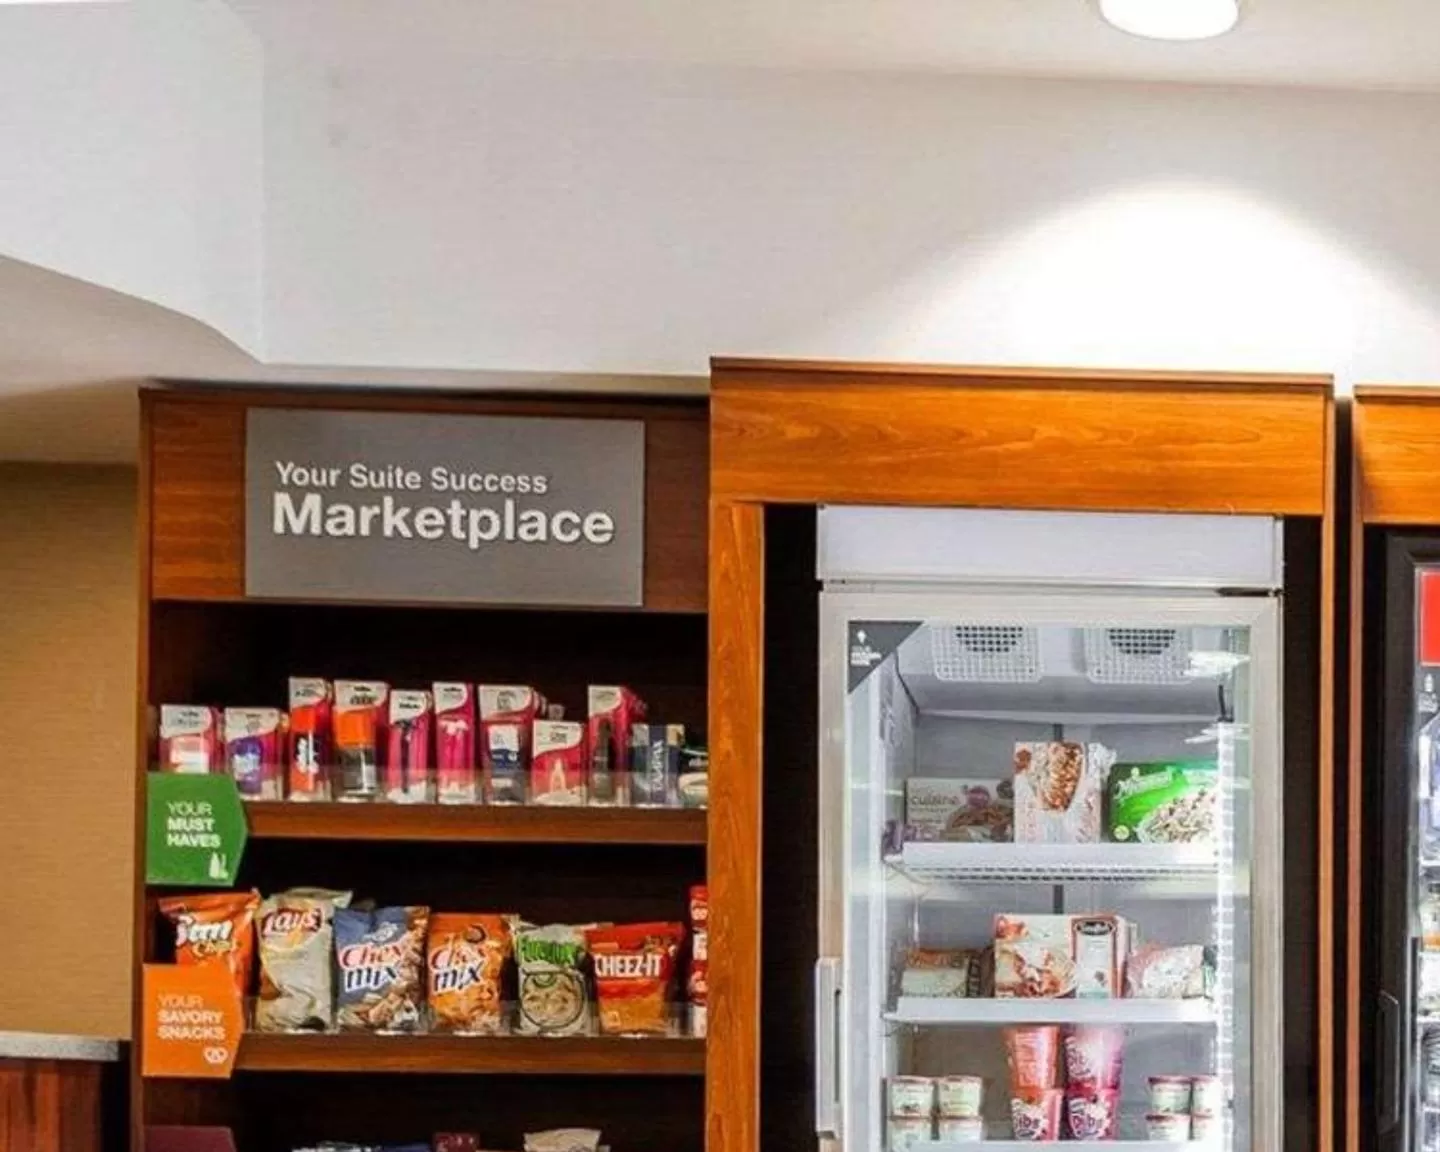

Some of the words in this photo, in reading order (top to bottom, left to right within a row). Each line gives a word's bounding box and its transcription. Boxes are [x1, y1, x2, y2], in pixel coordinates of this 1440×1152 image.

[275, 461, 341, 488] Your
[349, 464, 422, 491] Suite
[430, 467, 548, 494] Success
[272, 491, 615, 549] Marketplace
[168, 802, 213, 817] YOUR
[167, 817, 215, 832] MUST
[166, 832, 221, 848] HAVES
[158, 994, 204, 1008] YOUR
[157, 1009, 224, 1025] SAVORY
[157, 1025, 226, 1041] SNACKS
